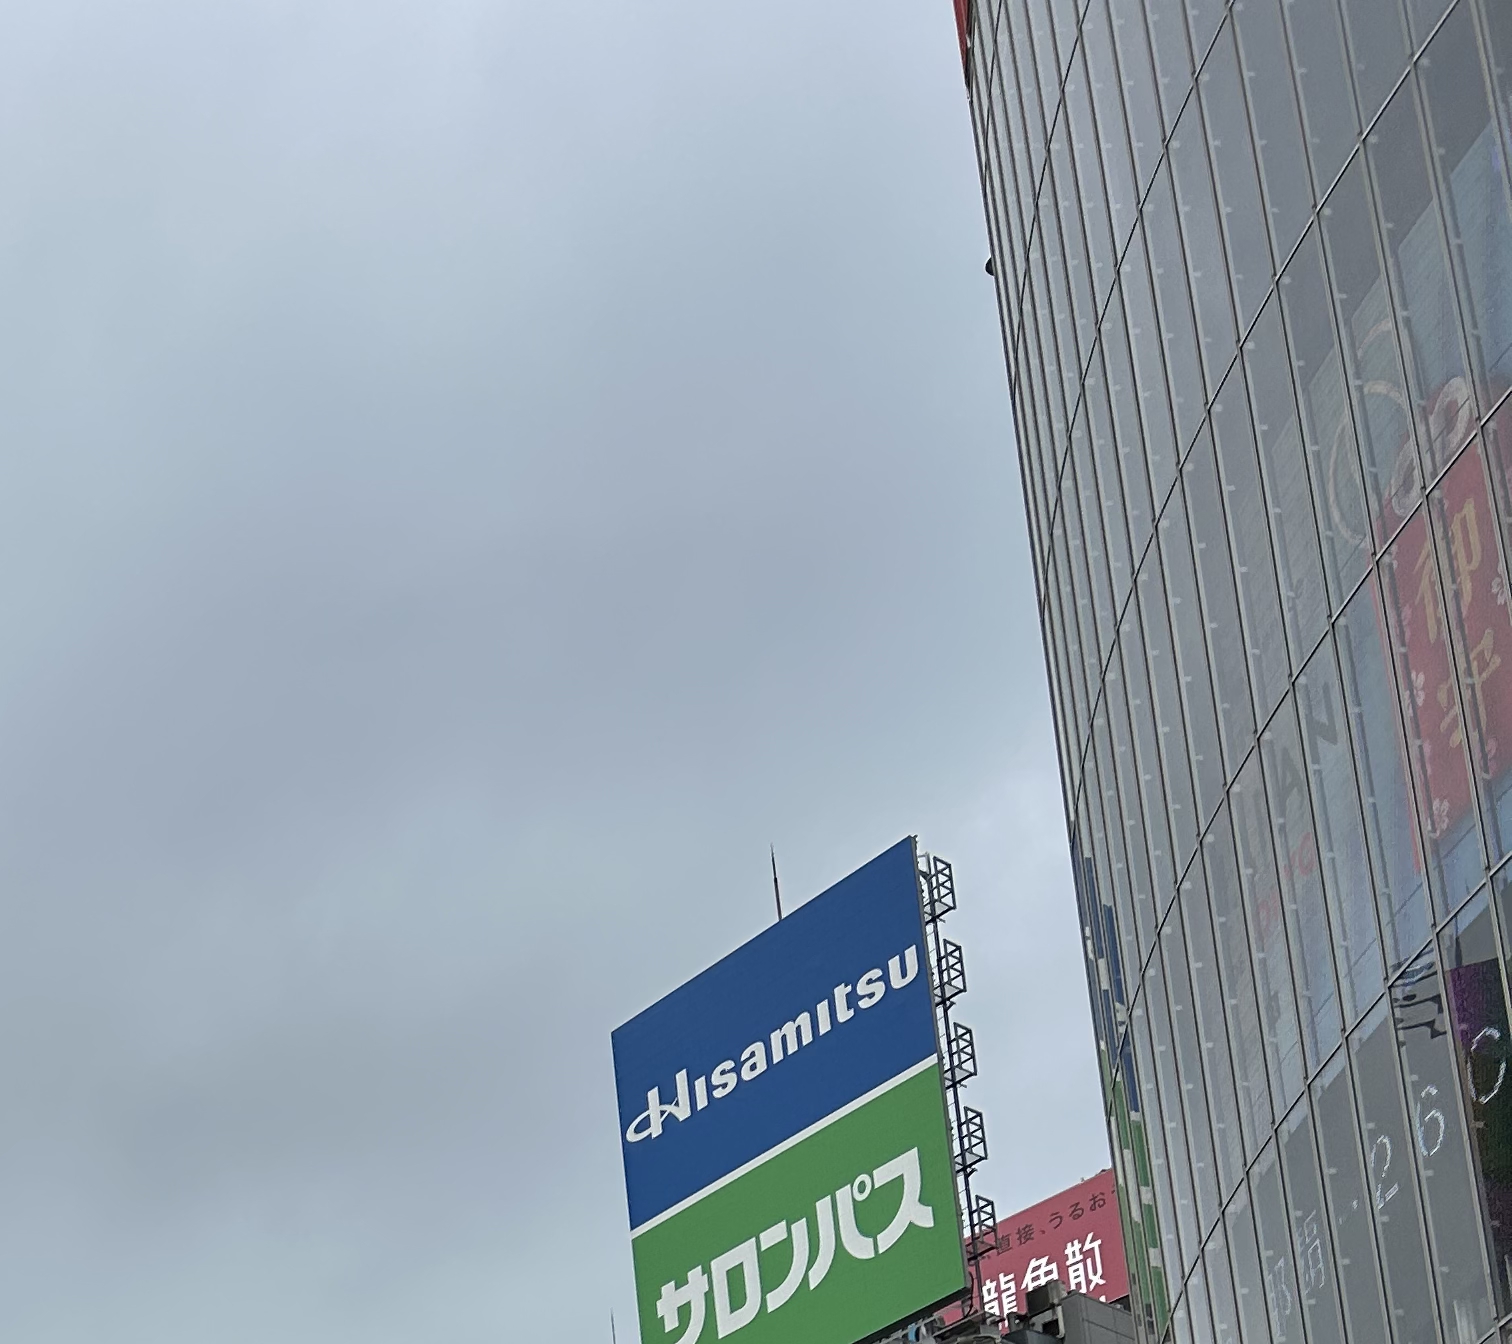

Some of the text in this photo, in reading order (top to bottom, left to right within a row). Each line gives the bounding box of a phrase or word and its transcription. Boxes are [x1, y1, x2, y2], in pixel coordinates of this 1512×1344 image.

[625, 943, 919, 1144] Hisamitsu
[996, 1192, 1108, 1256] 直接、うるお
